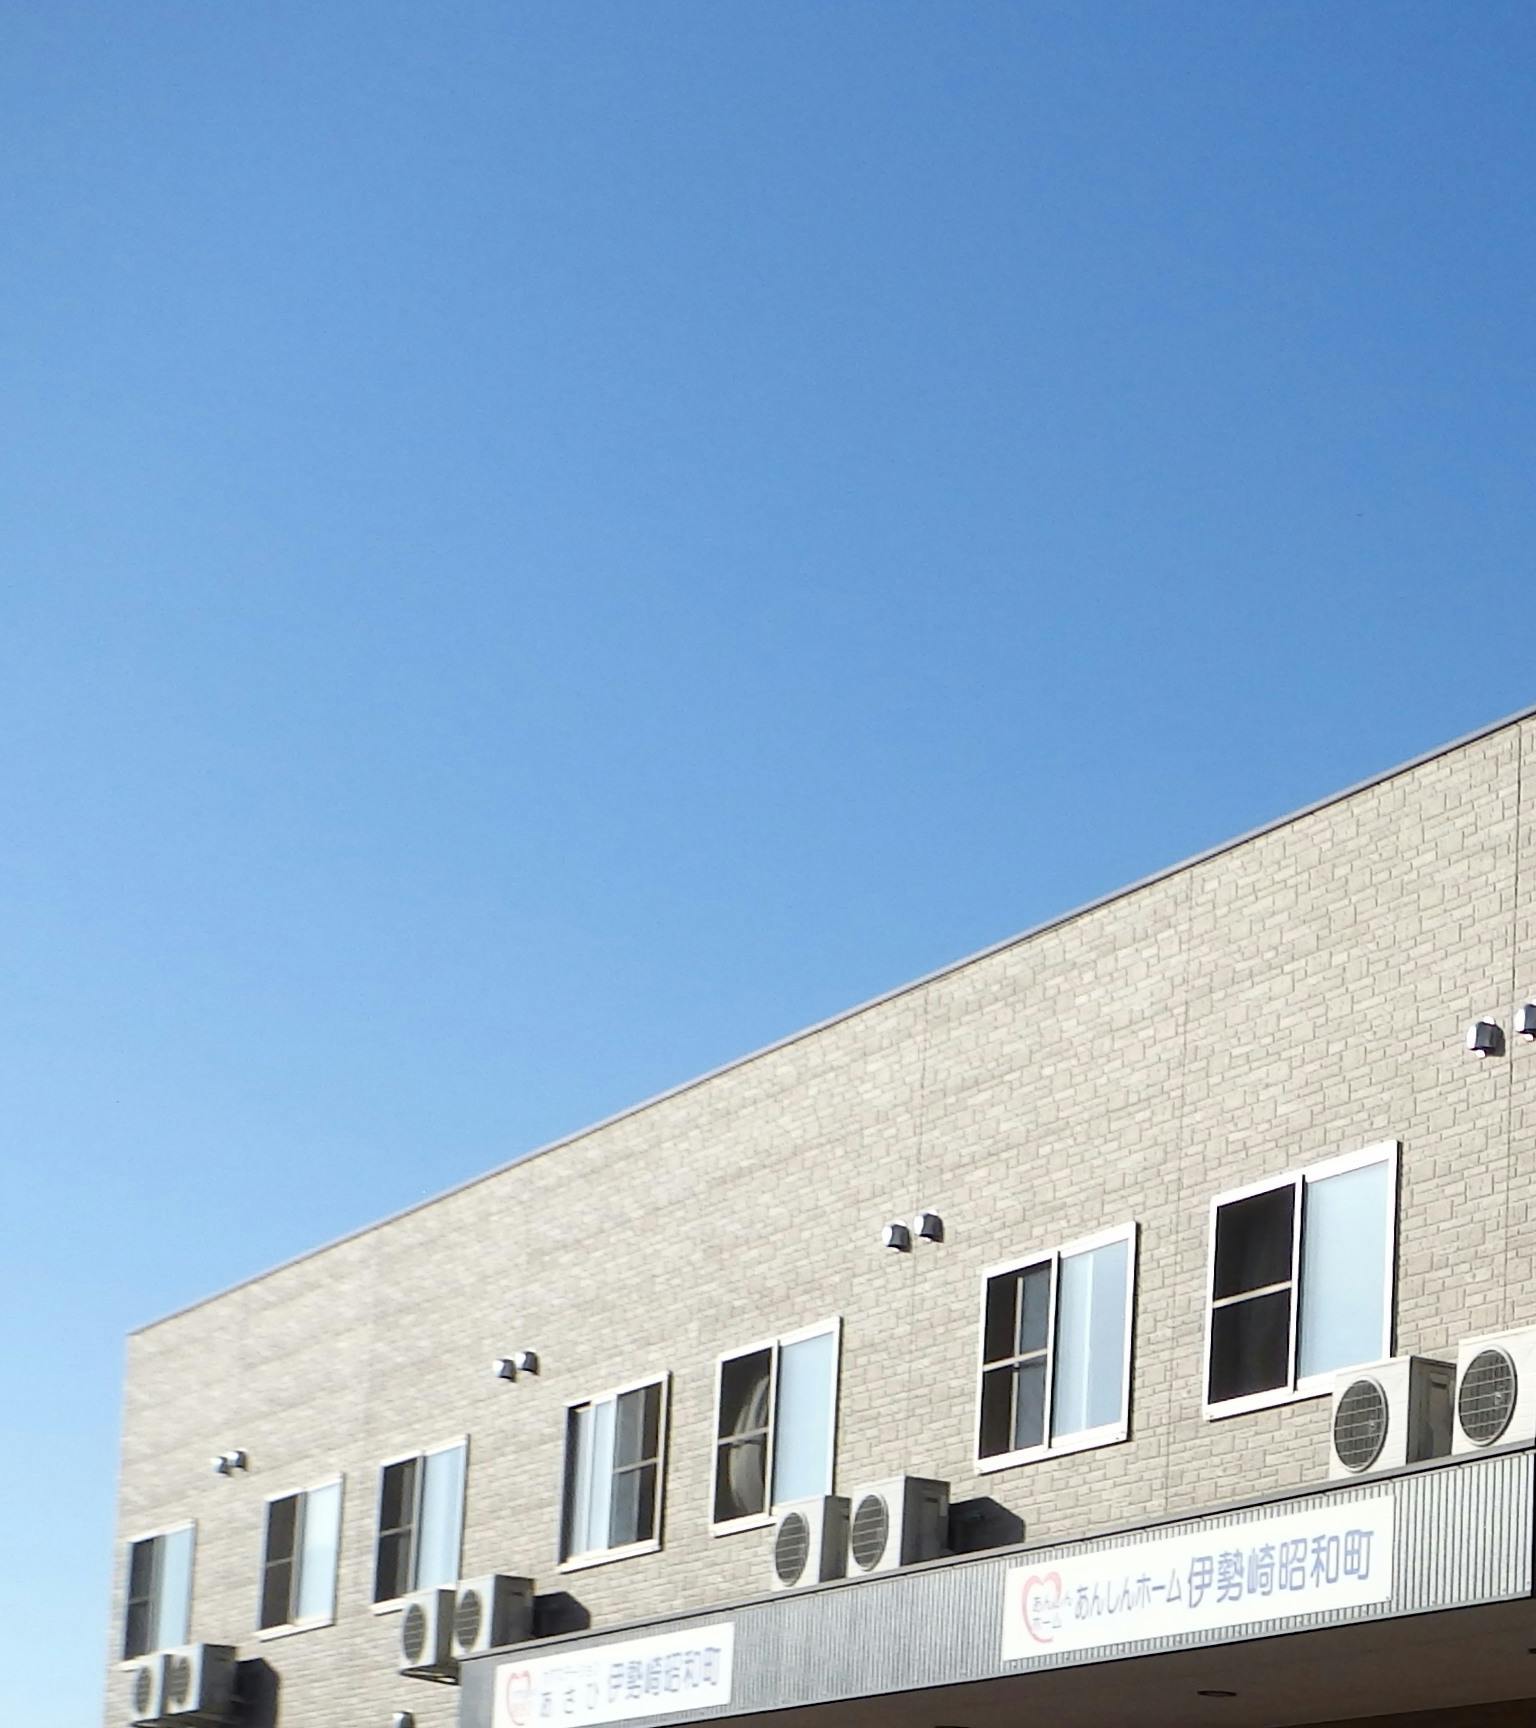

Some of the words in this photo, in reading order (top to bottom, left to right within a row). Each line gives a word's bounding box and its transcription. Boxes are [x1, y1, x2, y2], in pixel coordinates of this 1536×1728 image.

[1074, 1567, 1183, 1621] あんしんホーム
[1187, 1528, 1375, 1608] 伊勢崎昭和町
